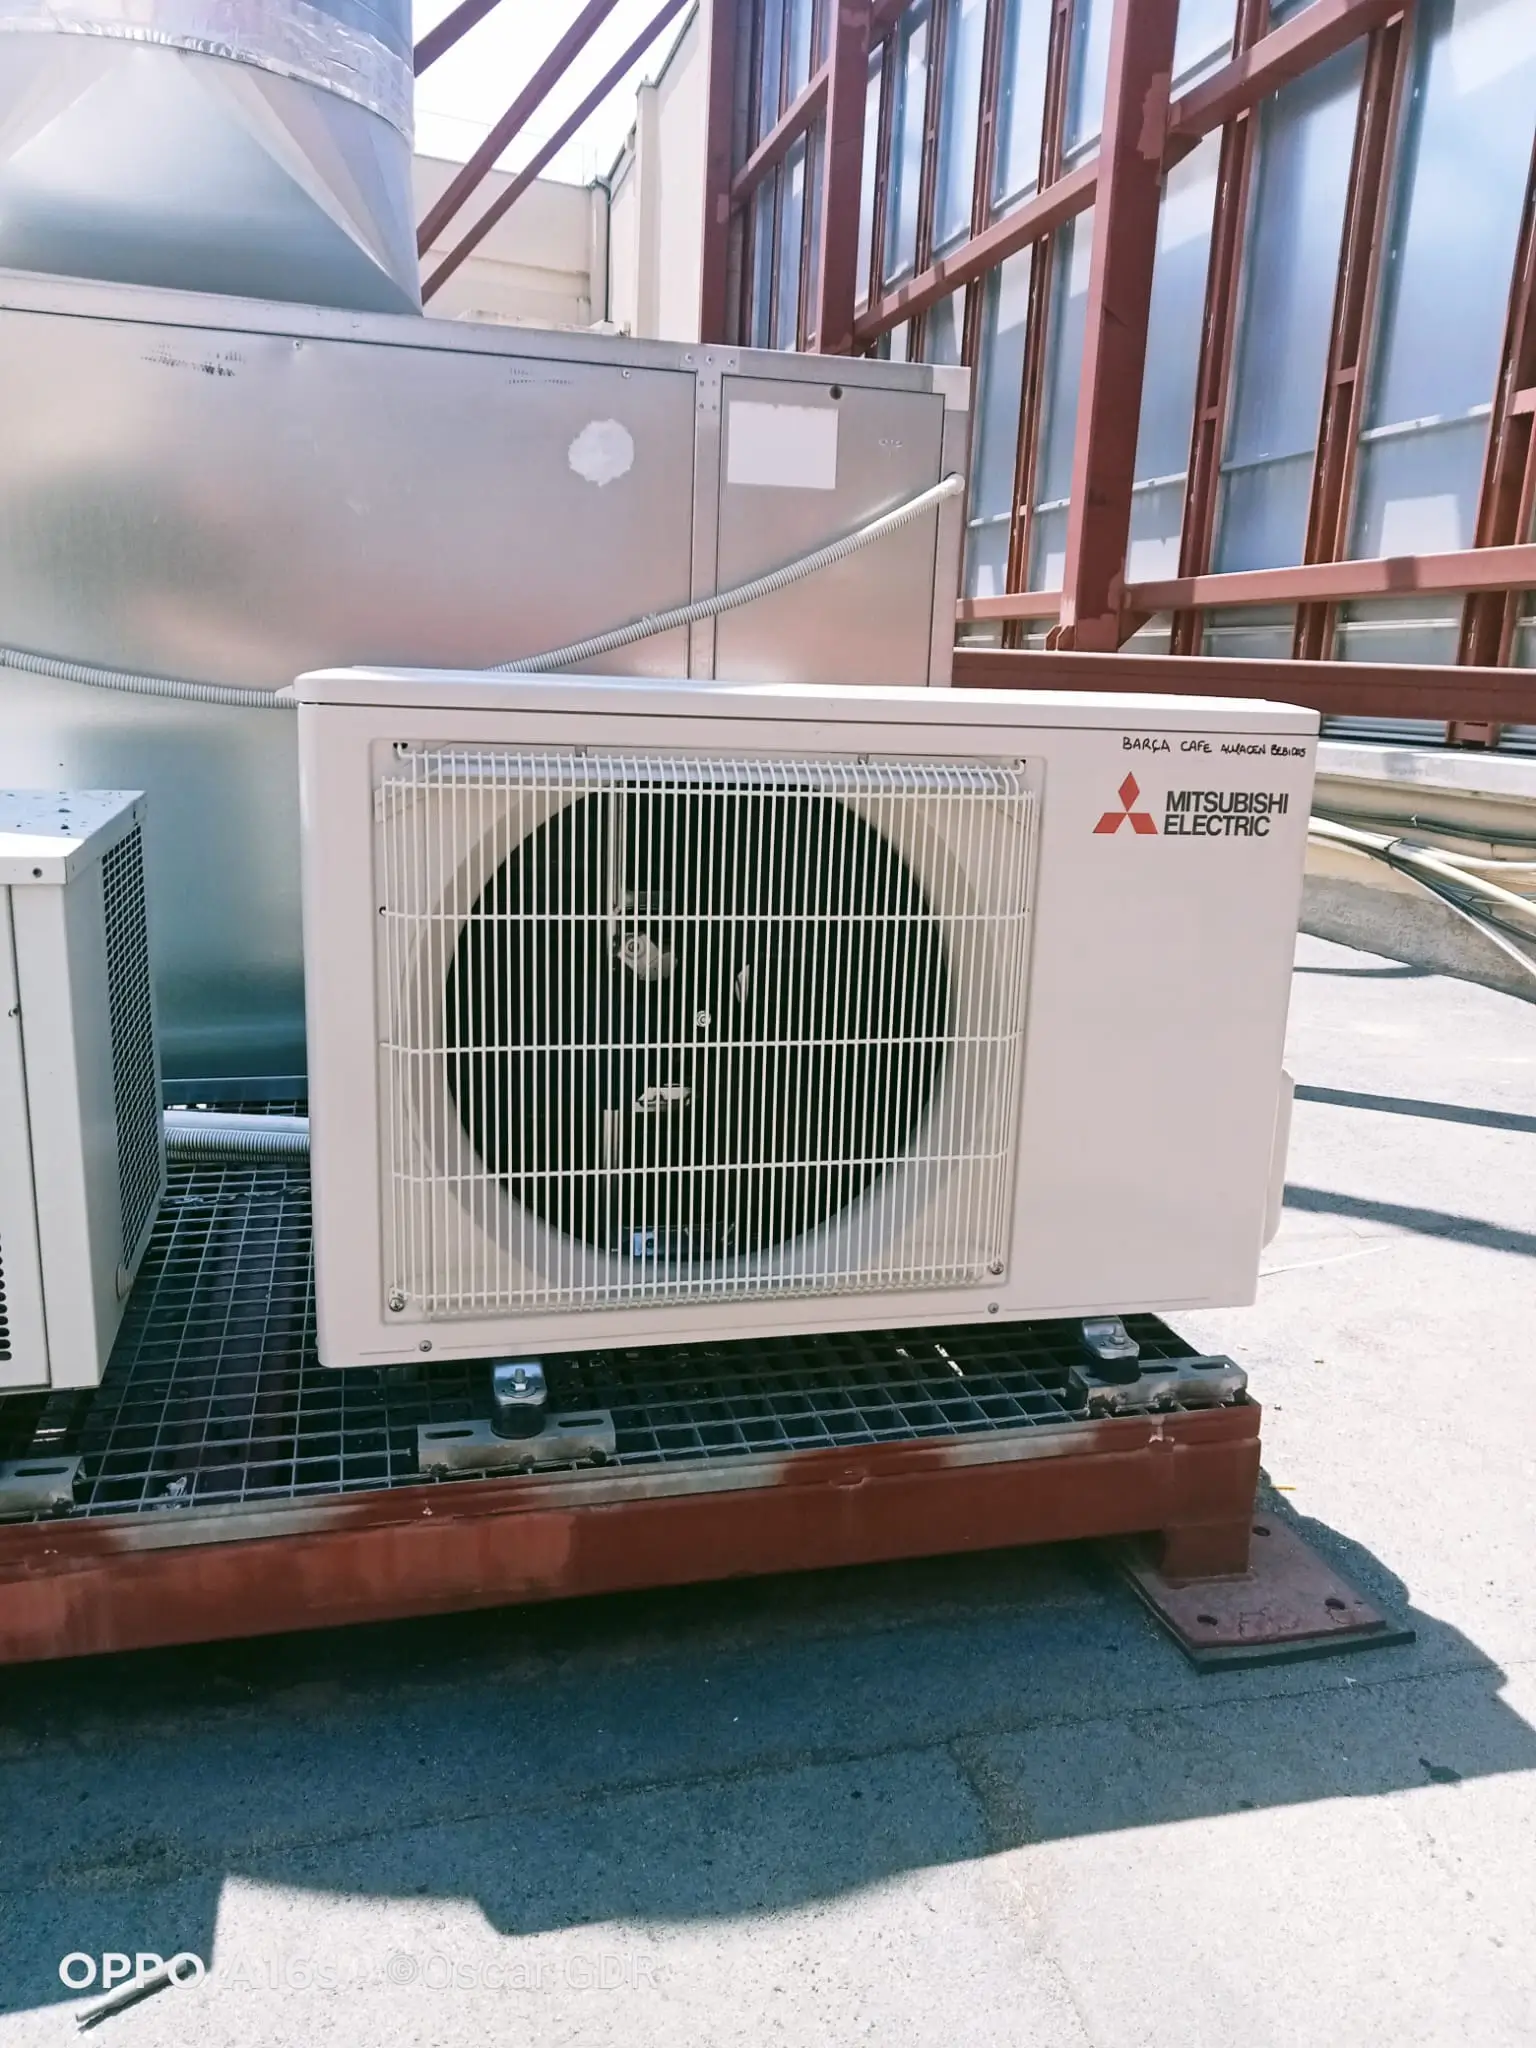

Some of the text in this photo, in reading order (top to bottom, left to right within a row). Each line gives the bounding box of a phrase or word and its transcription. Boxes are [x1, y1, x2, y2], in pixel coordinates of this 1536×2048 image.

[1180, 740, 1212, 753] CAFE
[1166, 790, 1289, 814] MITSUBISHI
[1163, 814, 1271, 837] ELECTRIC
